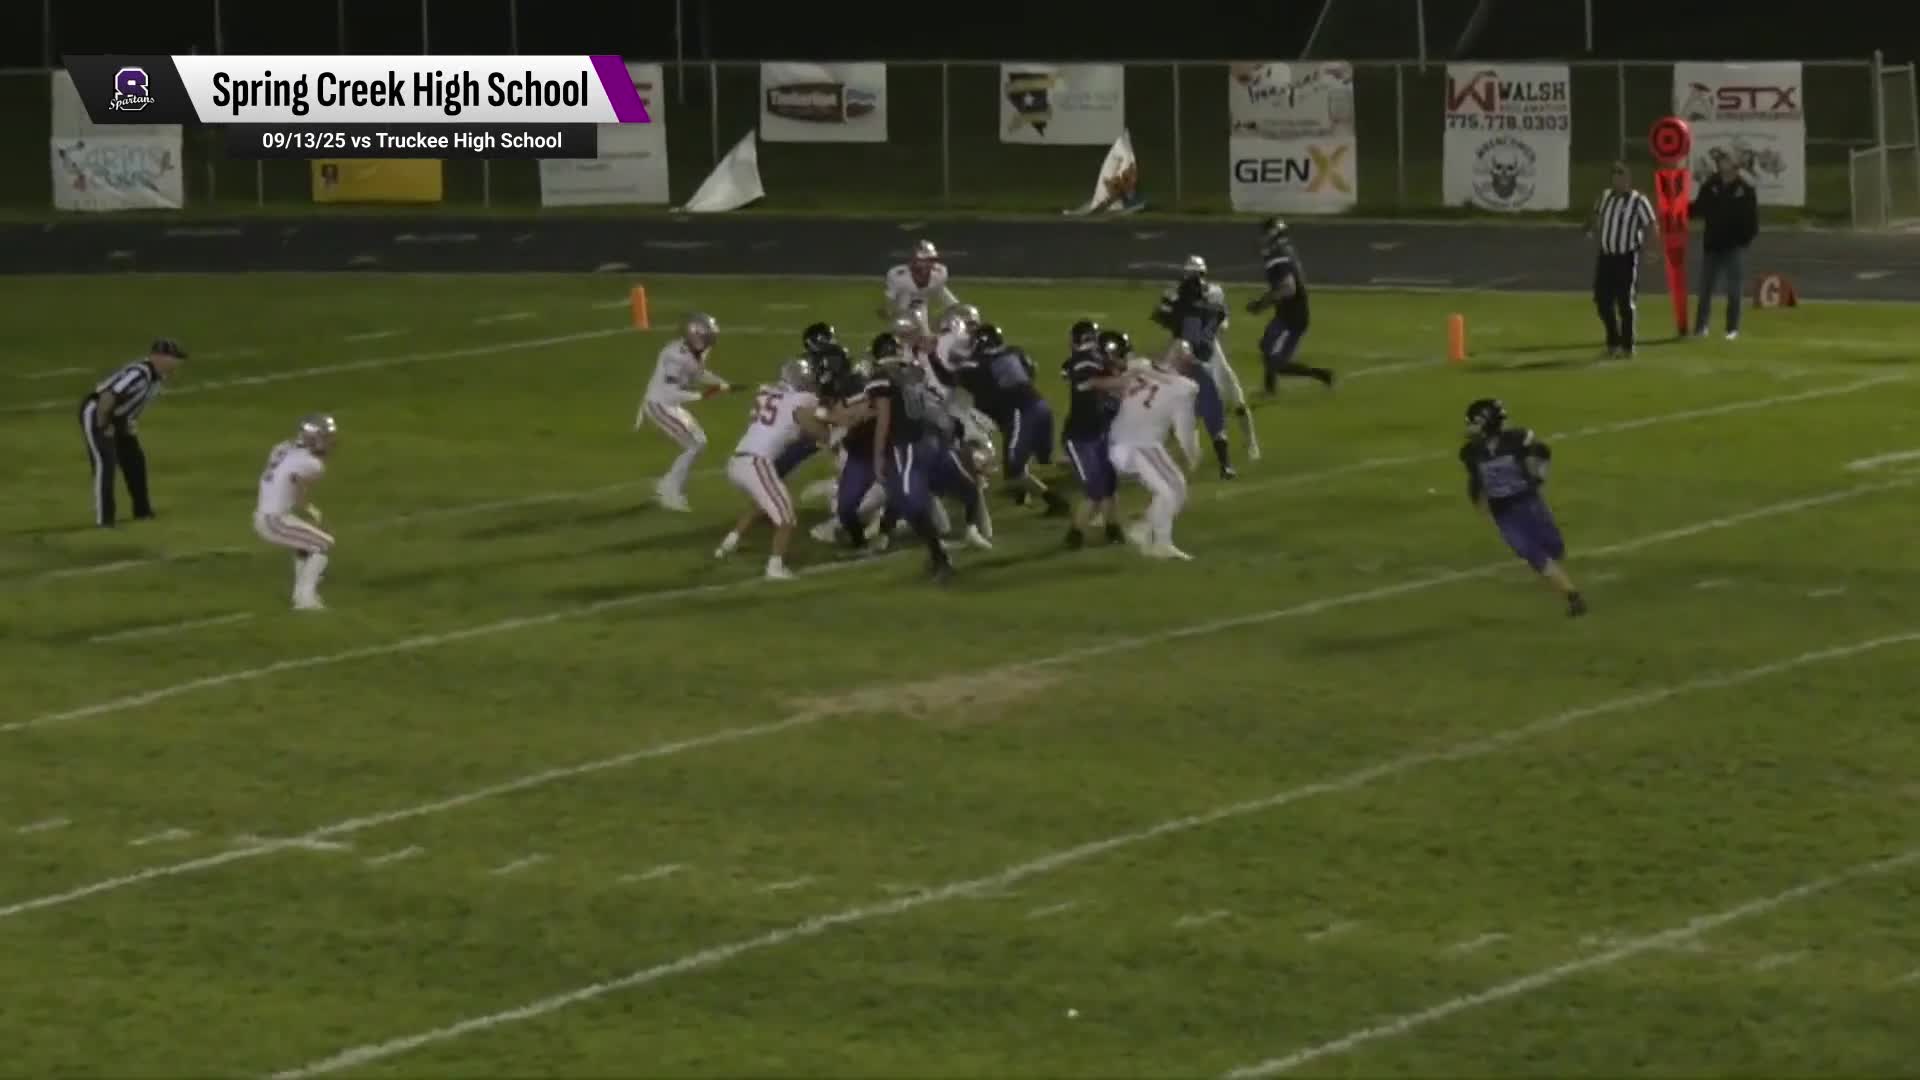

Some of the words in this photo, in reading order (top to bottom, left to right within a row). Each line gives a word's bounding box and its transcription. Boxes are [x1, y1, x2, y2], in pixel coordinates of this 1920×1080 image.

[1499, 81, 1566, 101] WALSH
[1716, 86, 1796, 110] STX
[1758, 275, 1782, 306] G
